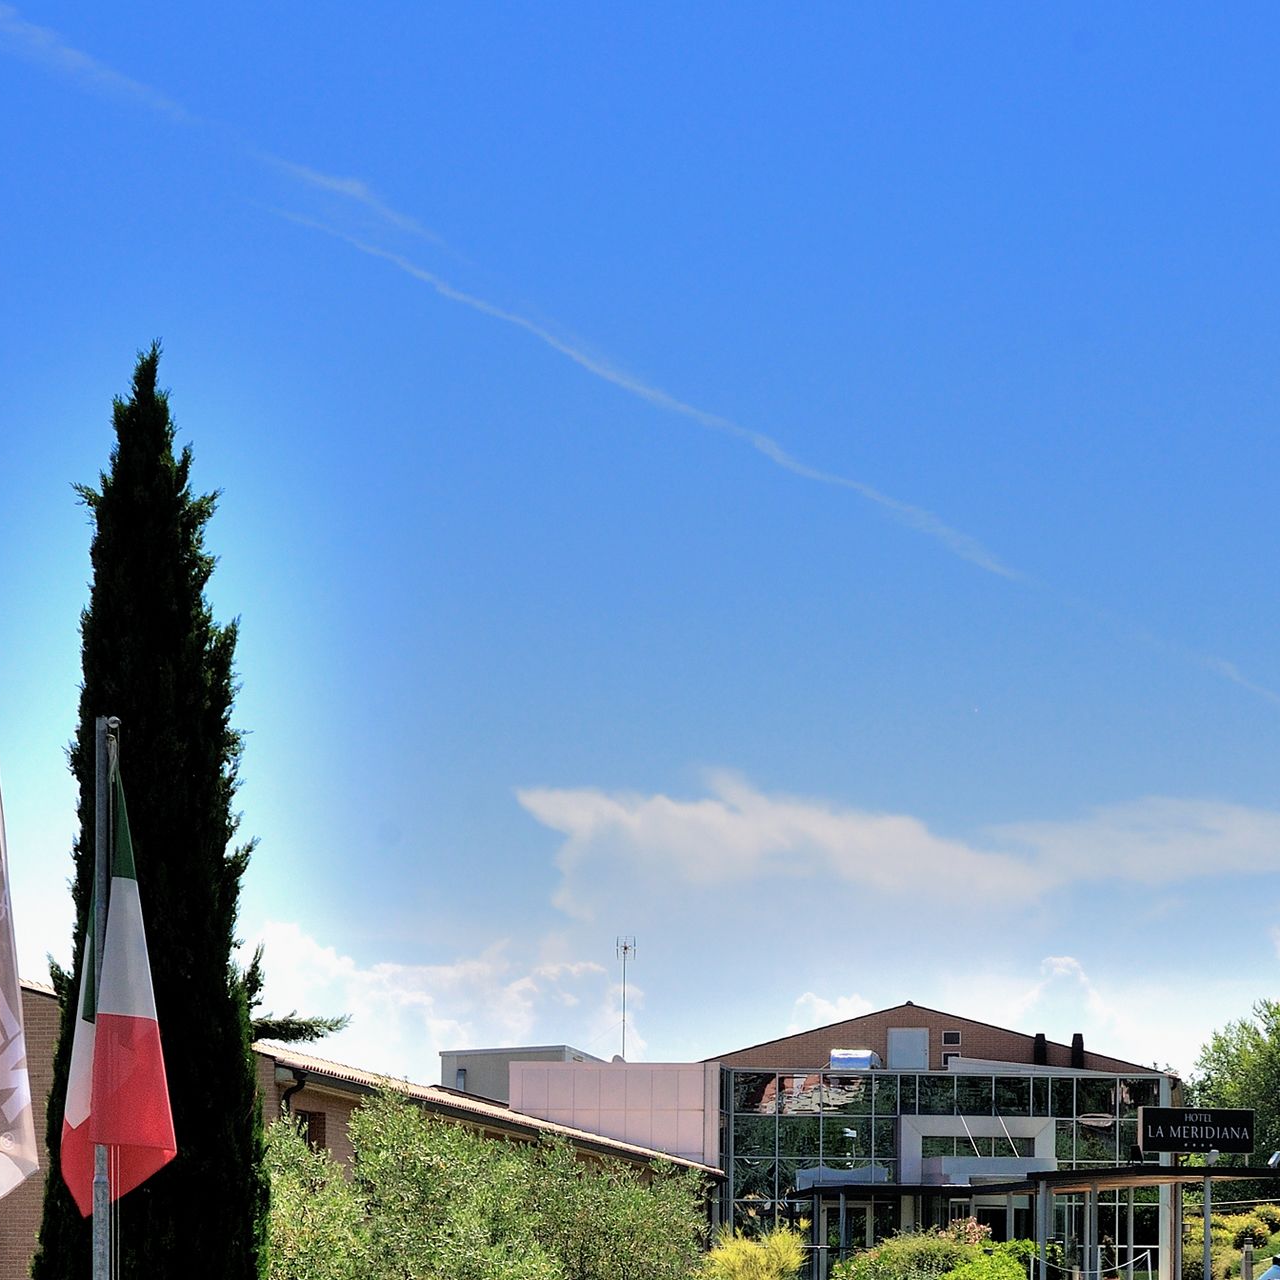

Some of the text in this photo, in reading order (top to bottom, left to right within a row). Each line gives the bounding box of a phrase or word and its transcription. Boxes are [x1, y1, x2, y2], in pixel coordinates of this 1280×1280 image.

[1184, 1113, 1212, 1123] HOTEL
[1148, 1125, 1250, 1140] LA MERIDIANA
